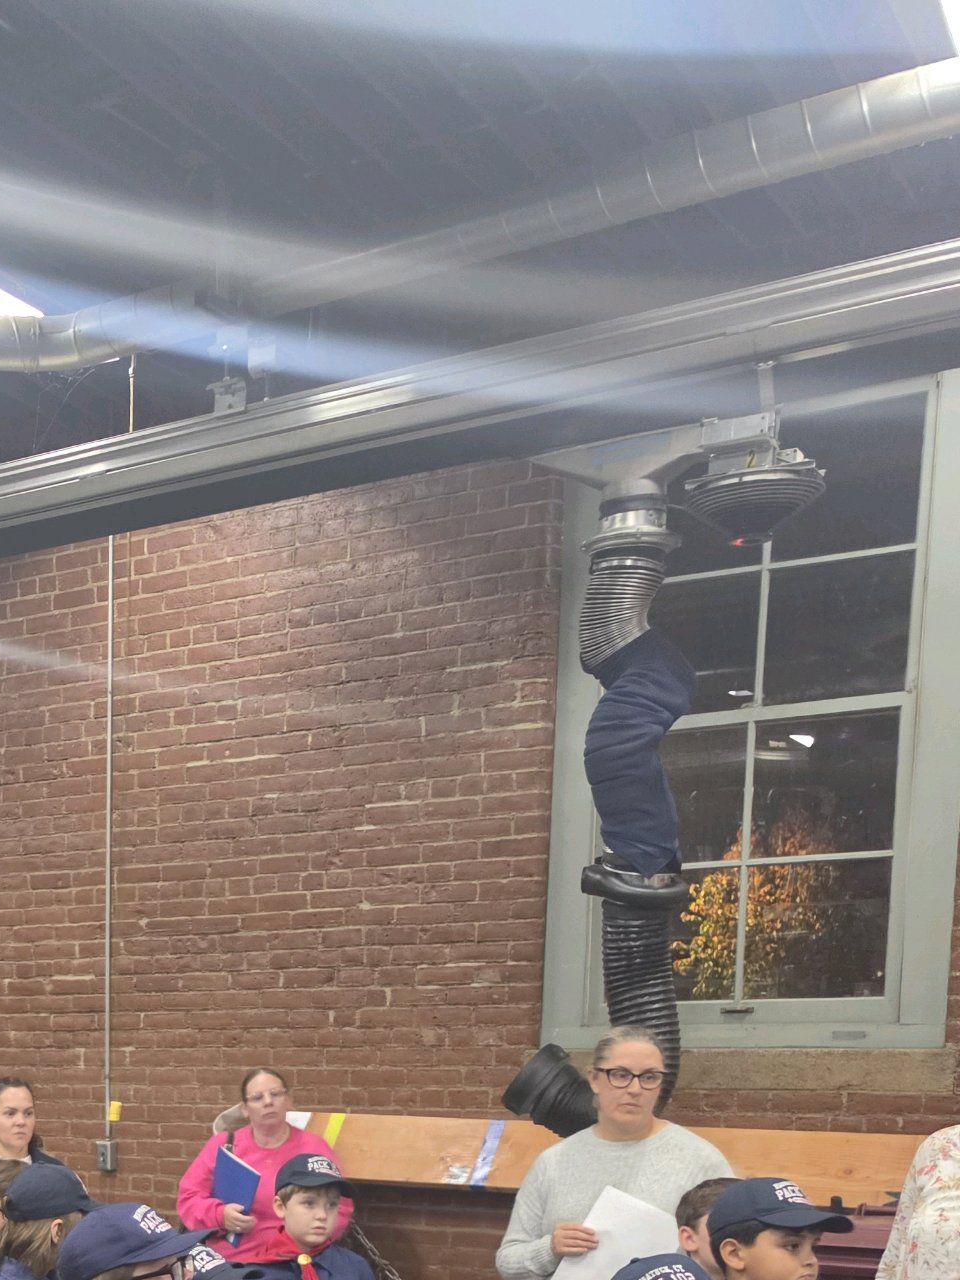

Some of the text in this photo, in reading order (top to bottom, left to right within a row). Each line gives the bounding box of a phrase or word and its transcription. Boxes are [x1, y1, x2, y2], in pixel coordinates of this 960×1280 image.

[307, 1160, 330, 1171] PACK
[774, 1186, 804, 1201] PACK
[140, 1210, 165, 1234] PACK
